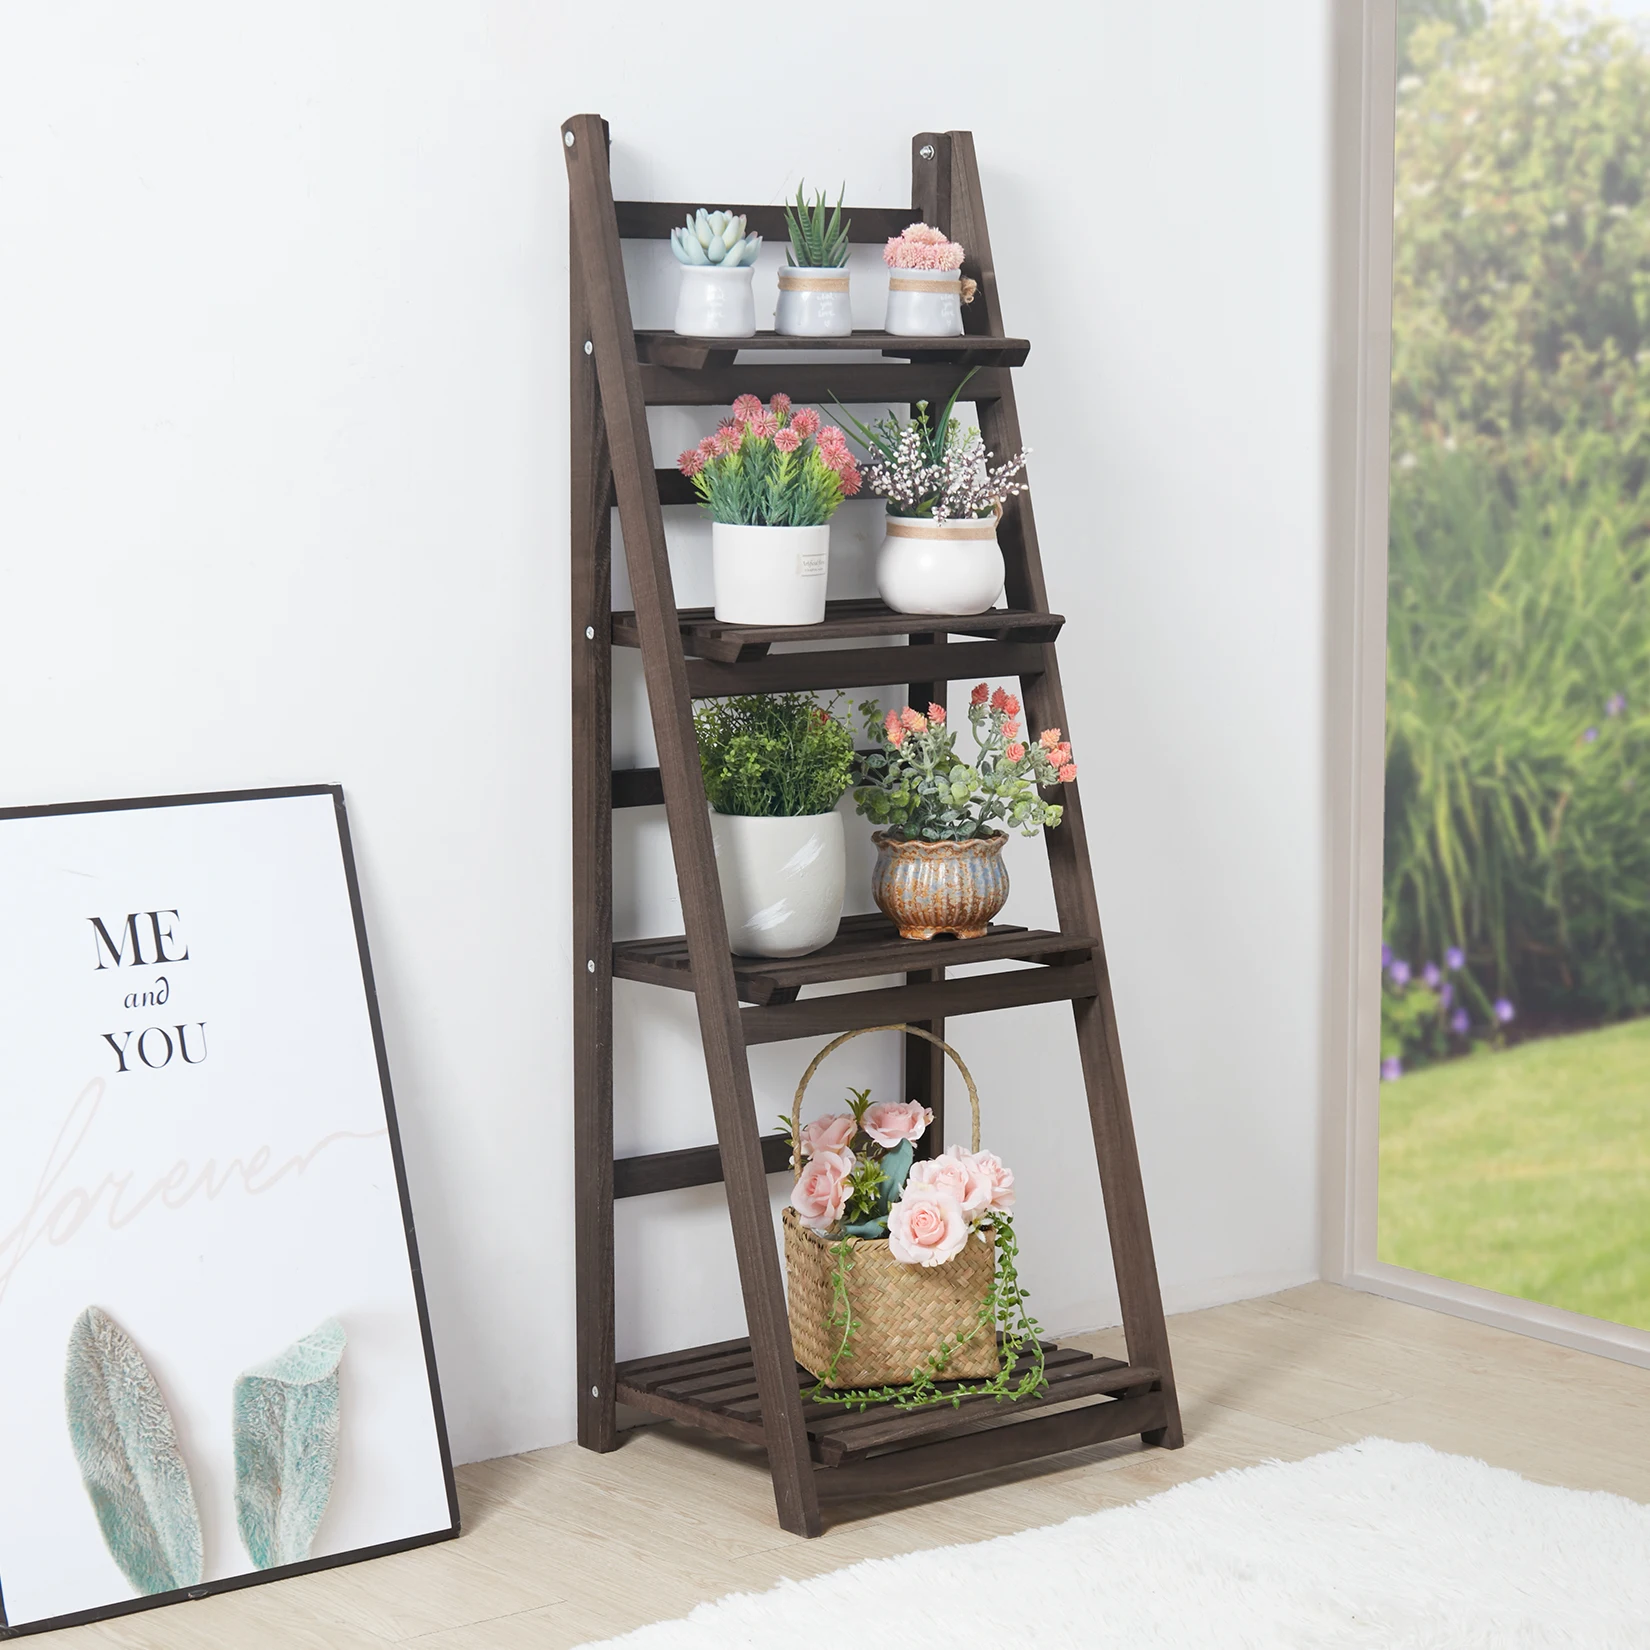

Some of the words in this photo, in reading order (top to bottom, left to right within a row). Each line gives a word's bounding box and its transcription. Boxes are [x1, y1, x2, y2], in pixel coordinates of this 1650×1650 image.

[86, 909, 189, 970] ME
[124, 976, 170, 1008] and
[100, 1021, 207, 1073] YOU
[0, 1076, 388, 1304] forever
